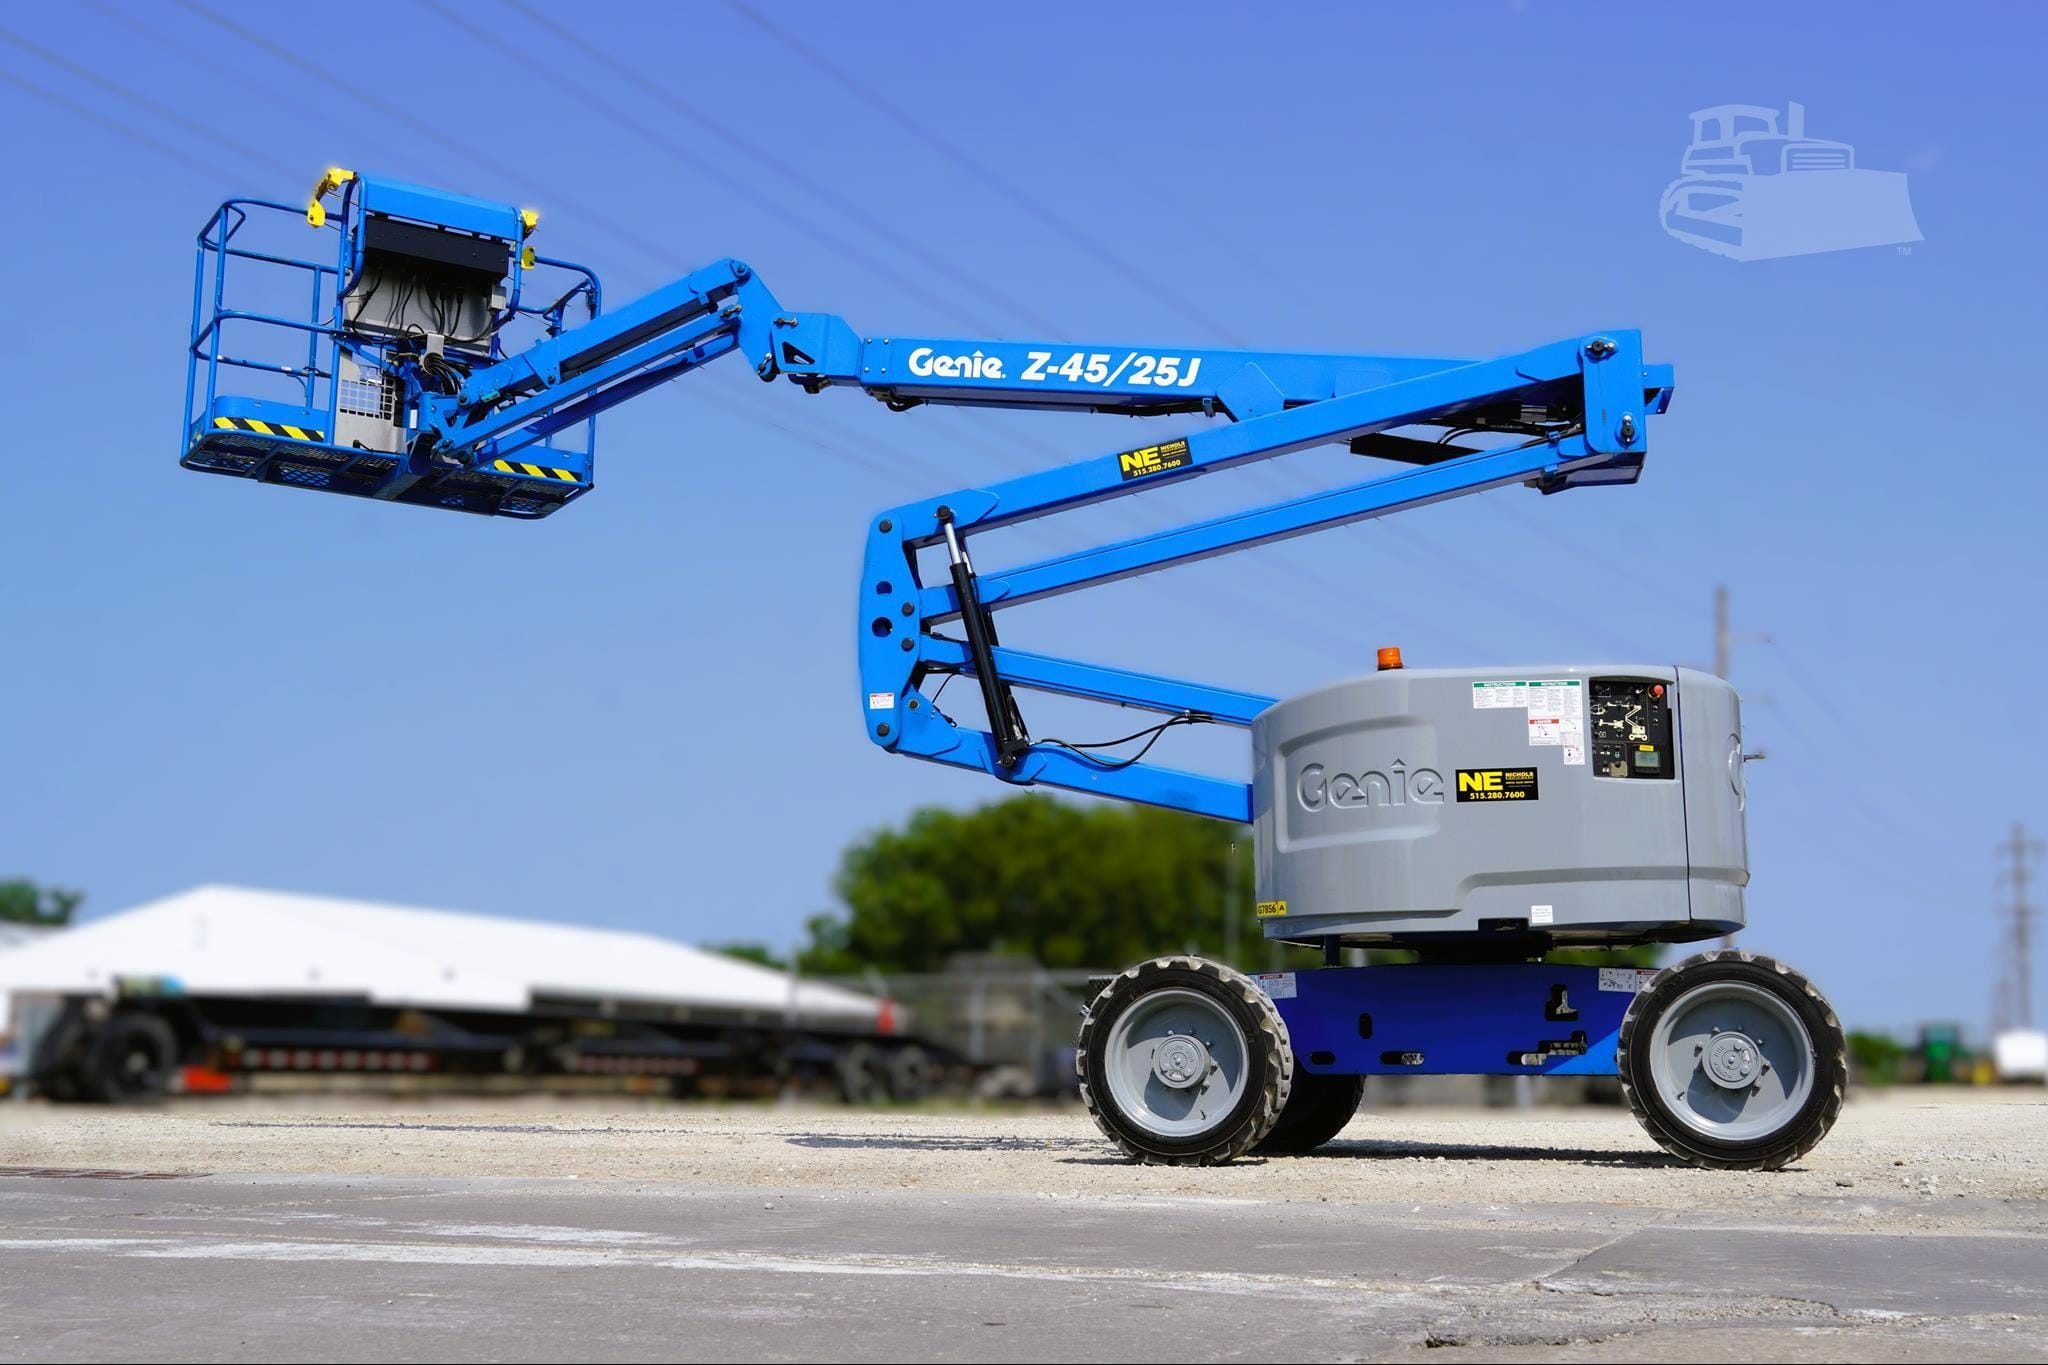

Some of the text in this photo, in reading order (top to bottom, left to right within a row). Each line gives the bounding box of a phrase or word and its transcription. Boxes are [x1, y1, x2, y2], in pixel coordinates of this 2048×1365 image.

[908, 347, 1202, 387] Genie Z-45/25J
[1120, 446, 1161, 472] NE
[1133, 459, 1181, 477] 515.280.7600
[1297, 758, 1445, 813] Genie
[1459, 771, 1504, 792] NE
[1469, 791, 1526, 800] 515.280.7600
